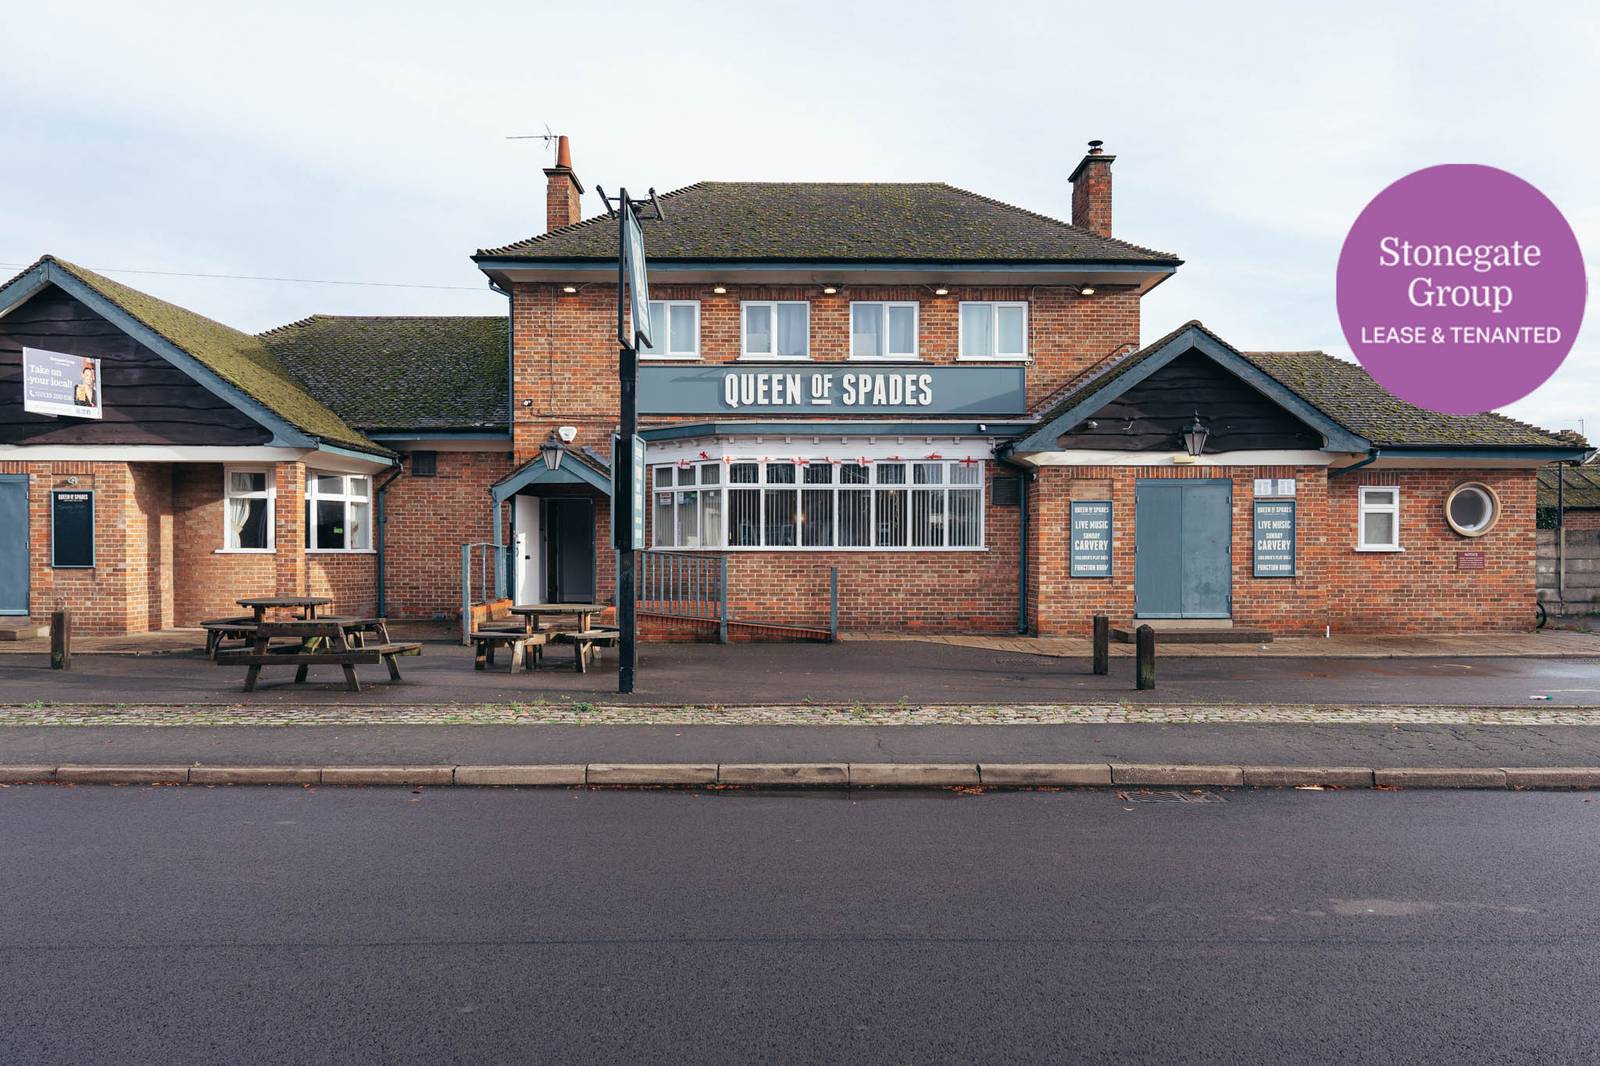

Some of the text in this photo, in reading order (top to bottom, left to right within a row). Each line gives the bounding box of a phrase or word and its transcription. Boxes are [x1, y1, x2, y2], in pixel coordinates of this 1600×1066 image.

[29, 364, 50, 375] Take
[50, 368, 62, 377] on
[28, 375, 73, 389] your local!
[724, 373, 933, 408] QUEEN OF SPADES
[1075, 520, 1108, 528] LIVE MUSIC
[1258, 520, 1291, 528] LIVE MUSIC
[1075, 540, 1108, 550] CARVERY
[1258, 540, 1291, 550] CARVERY
